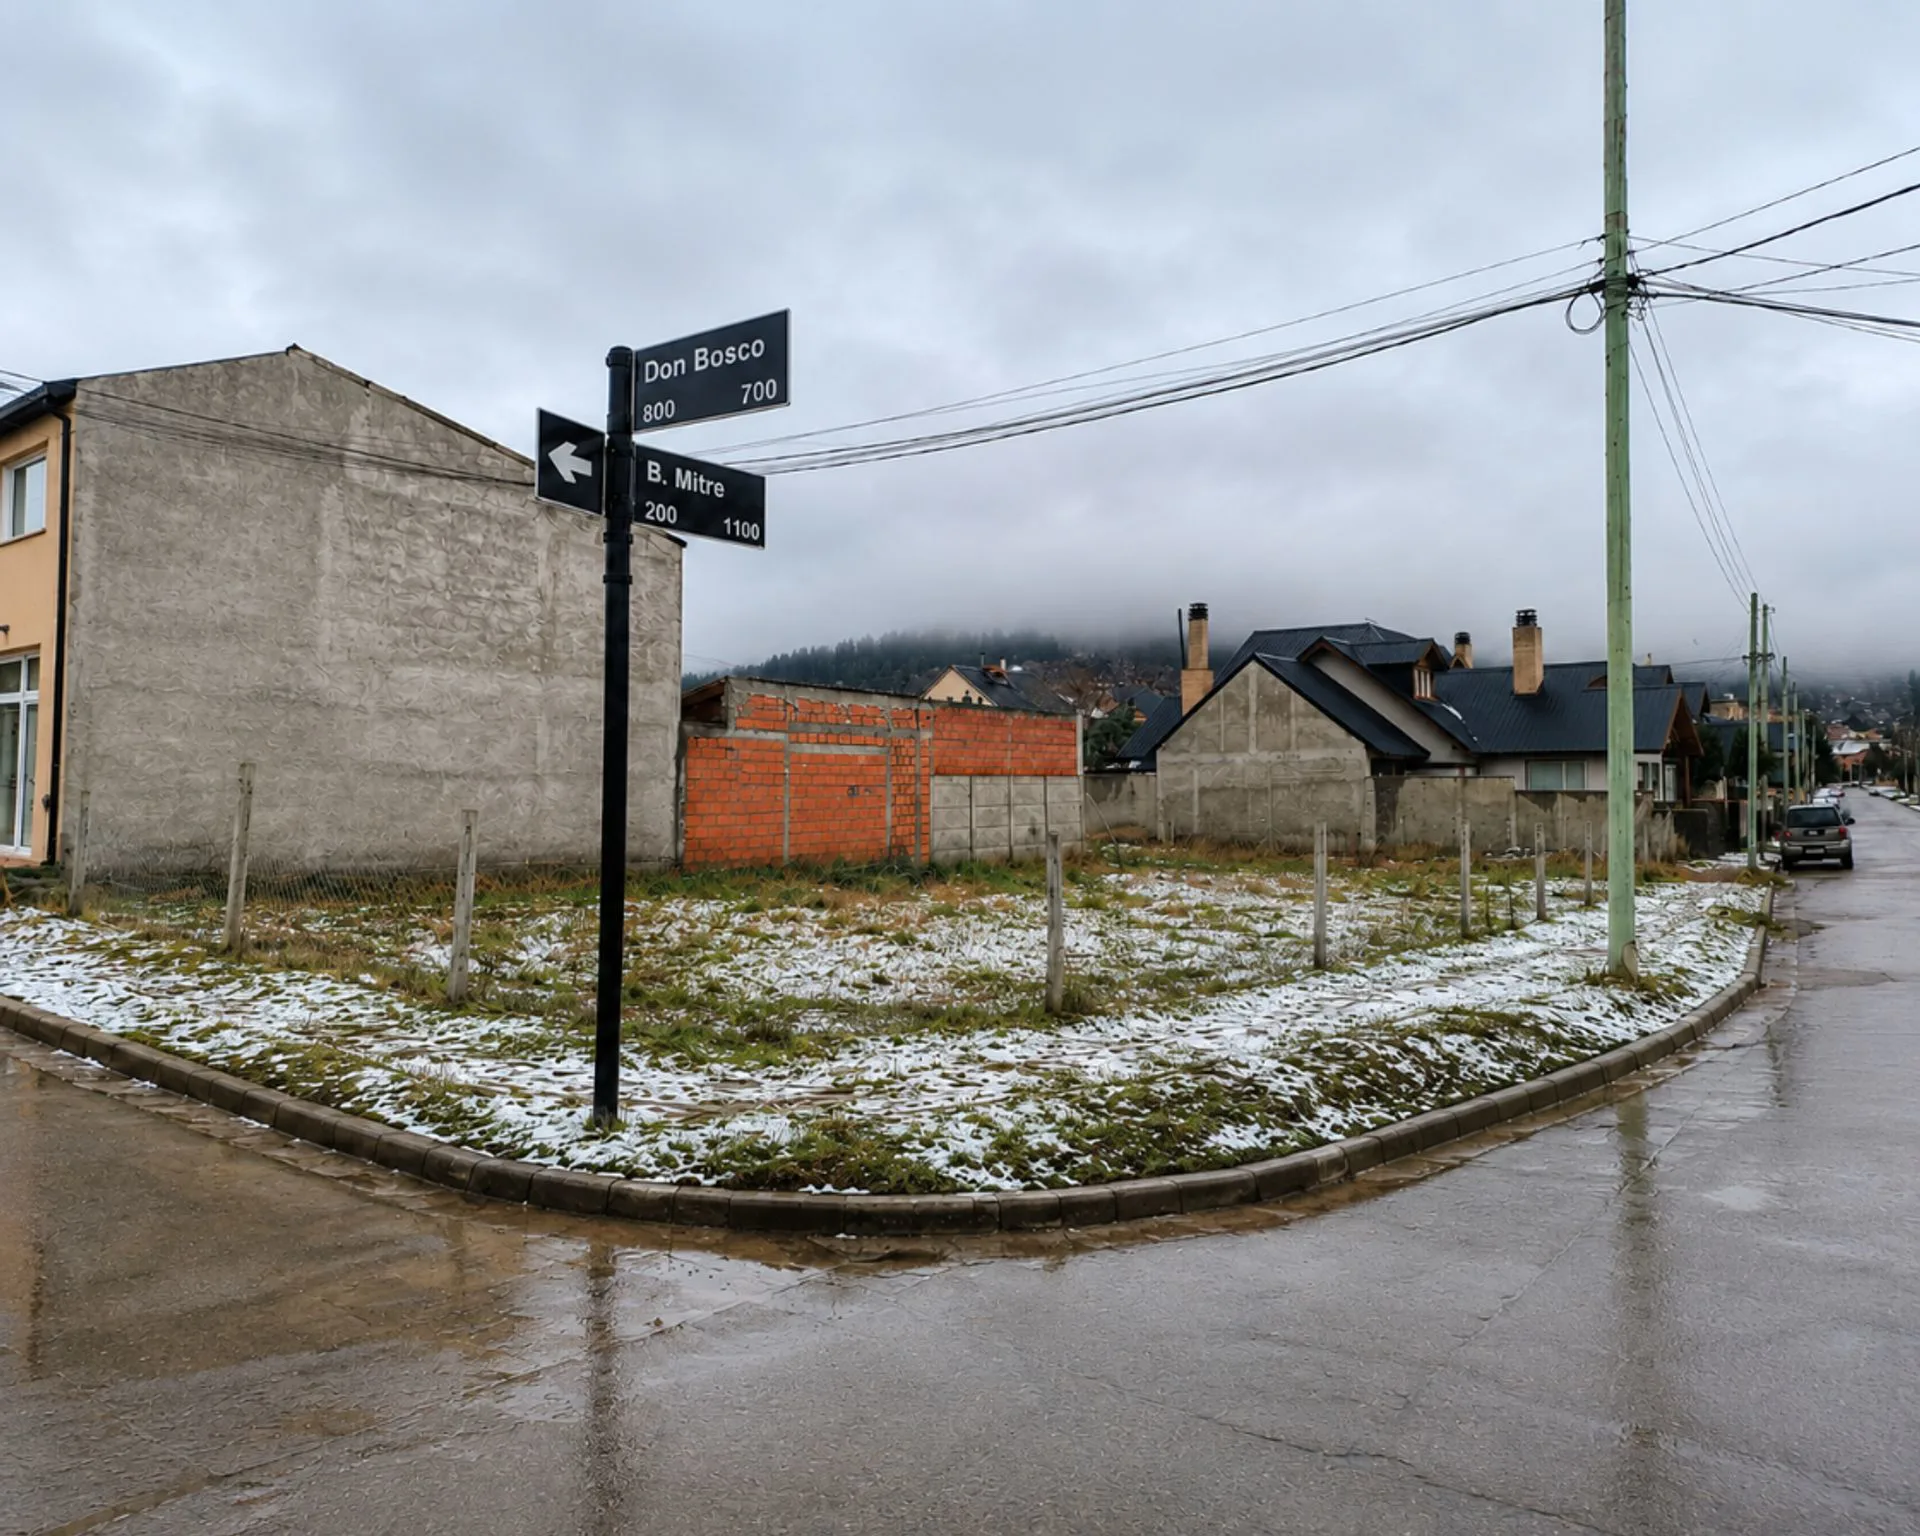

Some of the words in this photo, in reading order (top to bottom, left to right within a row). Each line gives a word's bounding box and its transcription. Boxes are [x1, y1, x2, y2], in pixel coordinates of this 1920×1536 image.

[644, 357, 686, 384] Don
[694, 338, 765, 371] Bosco
[741, 378, 778, 404] 700
[643, 399, 676, 423] 800
[647, 461, 668, 485] B.
[675, 467, 725, 498] Mitre
[645, 500, 678, 525] 200
[723, 517, 760, 540] 1100
